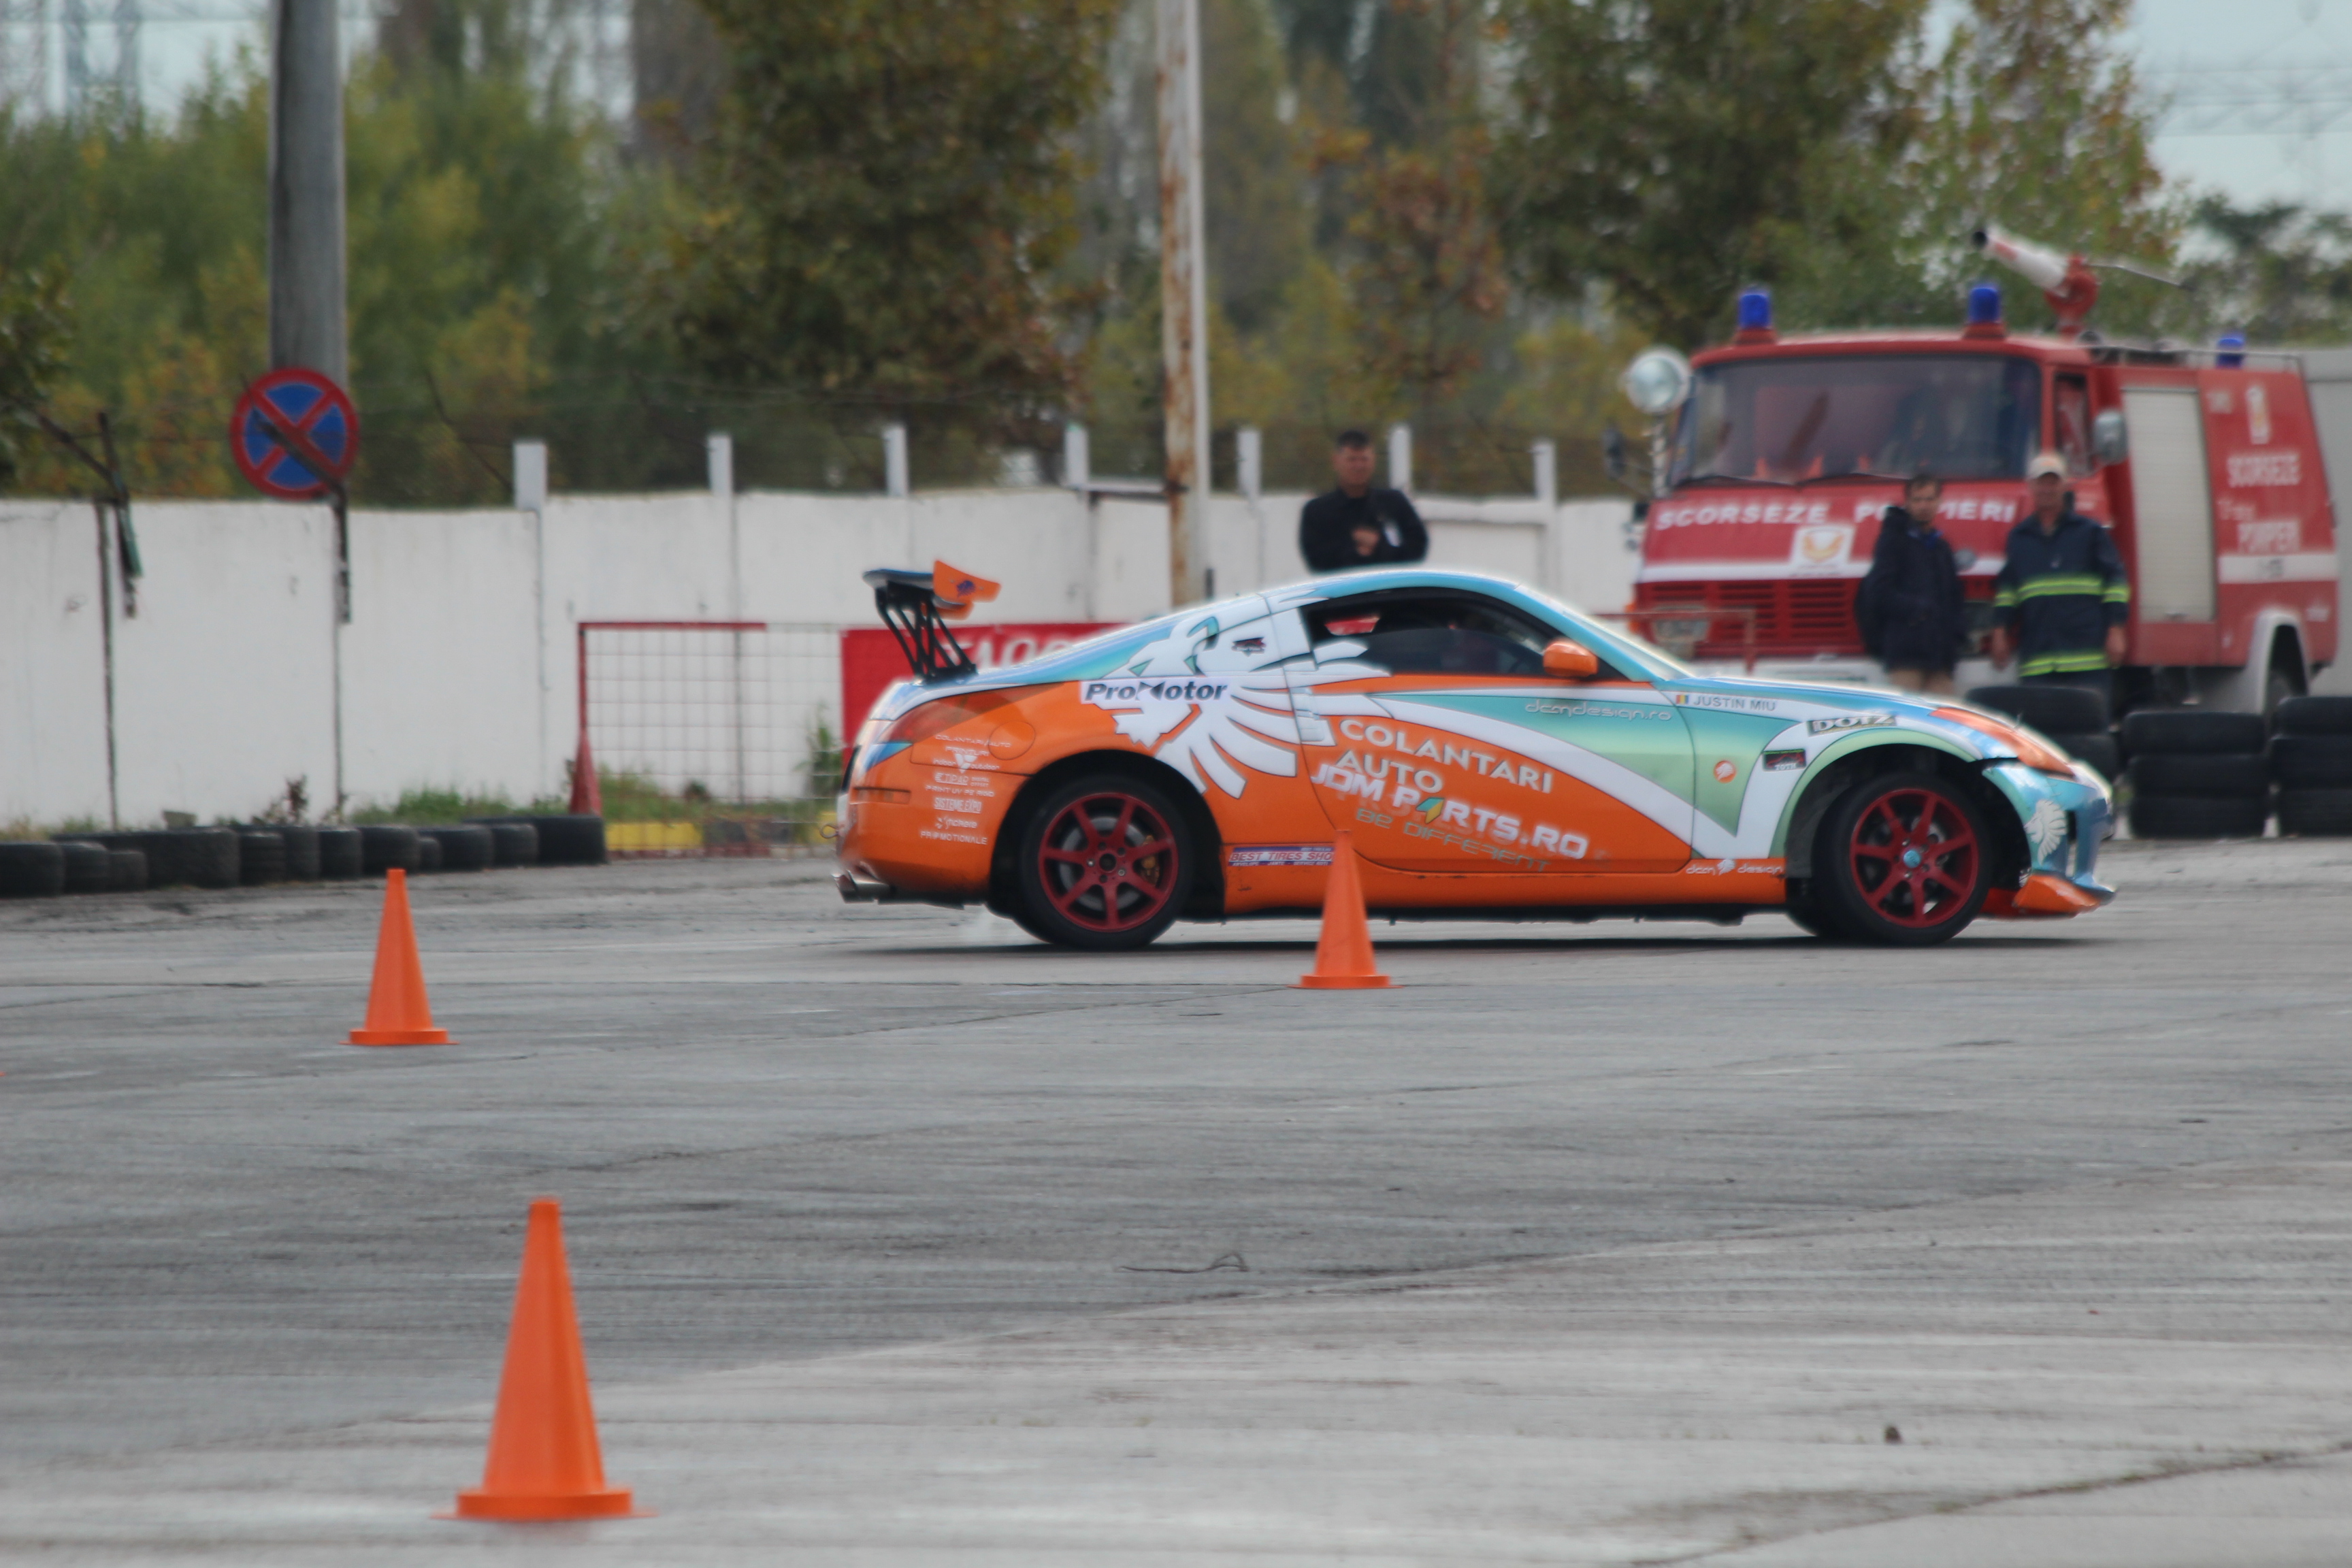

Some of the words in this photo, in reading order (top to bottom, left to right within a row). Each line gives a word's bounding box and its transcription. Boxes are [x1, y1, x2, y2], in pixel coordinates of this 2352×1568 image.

[1656, 504, 1829, 531] SCORSEZE
[1085, 681, 1228, 701] ProMotor
[1694, 696, 1745, 708] JUSTIN
[1750, 700, 1776, 711] MIU
[1812, 715, 1892, 732] DOTZ
[933, 758, 957, 766] indoor
[970, 762, 1000, 770] outdoor
[1339, 719, 1554, 794] COLANTARI
[1336, 749, 1444, 794] AUTO
[1310, 764, 1386, 802] JDM
[934, 797, 964, 811] SISTEME
[964, 799, 982, 812] EXPO
[1230, 852, 1263, 861] BEST
[1268, 852, 1303, 860] TIRES
[1737, 863, 1784, 875] design
